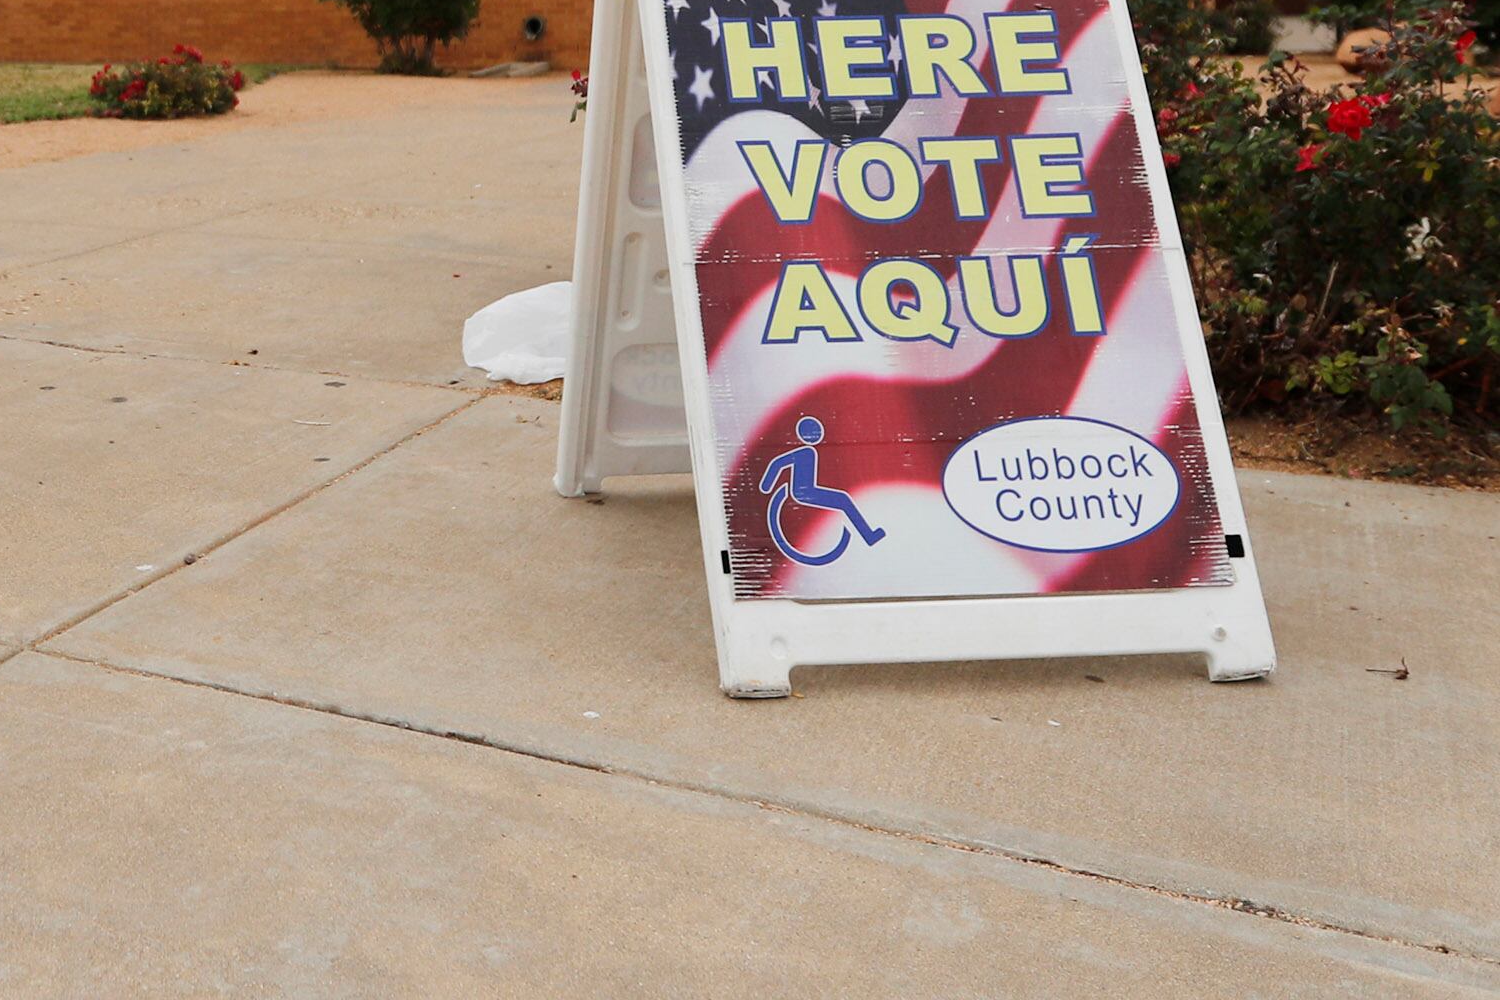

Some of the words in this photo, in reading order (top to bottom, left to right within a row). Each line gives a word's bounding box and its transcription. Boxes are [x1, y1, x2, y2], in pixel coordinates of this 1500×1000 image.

[719, 11, 1073, 103] HERE
[736, 133, 1097, 224] VOTE
[761, 233, 1107, 348] AQUÍ
[973, 445, 1154, 483] Lubbock
[995, 487, 1144, 528] County
